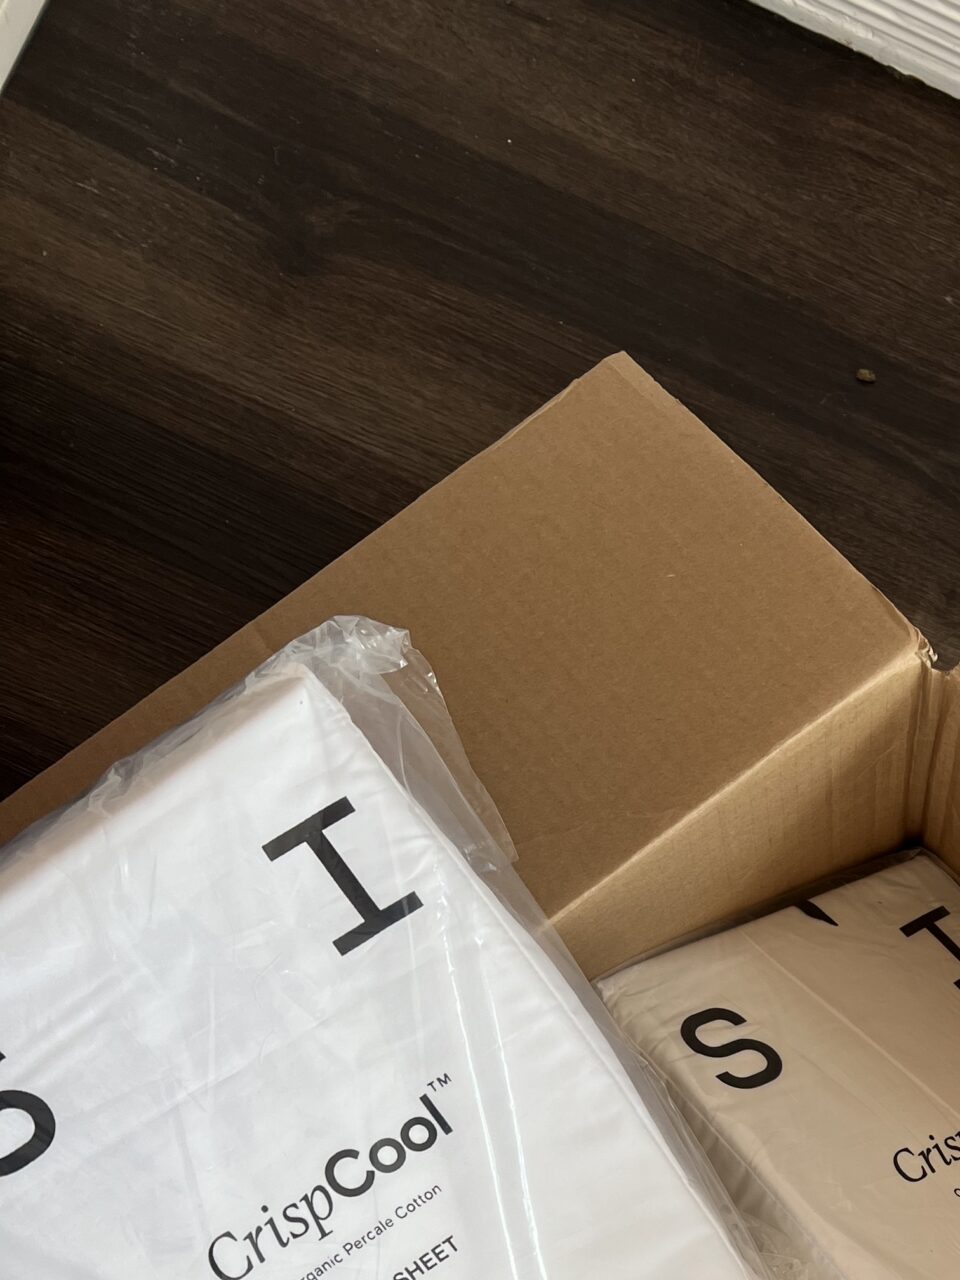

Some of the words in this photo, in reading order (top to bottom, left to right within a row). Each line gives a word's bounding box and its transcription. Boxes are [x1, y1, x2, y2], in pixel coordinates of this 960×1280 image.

[262, 797, 423, 955] I
[681, 1008, 782, 1089] S
[343, 1217, 395, 1256] Percale
[395, 1183, 443, 1220] Cotton
